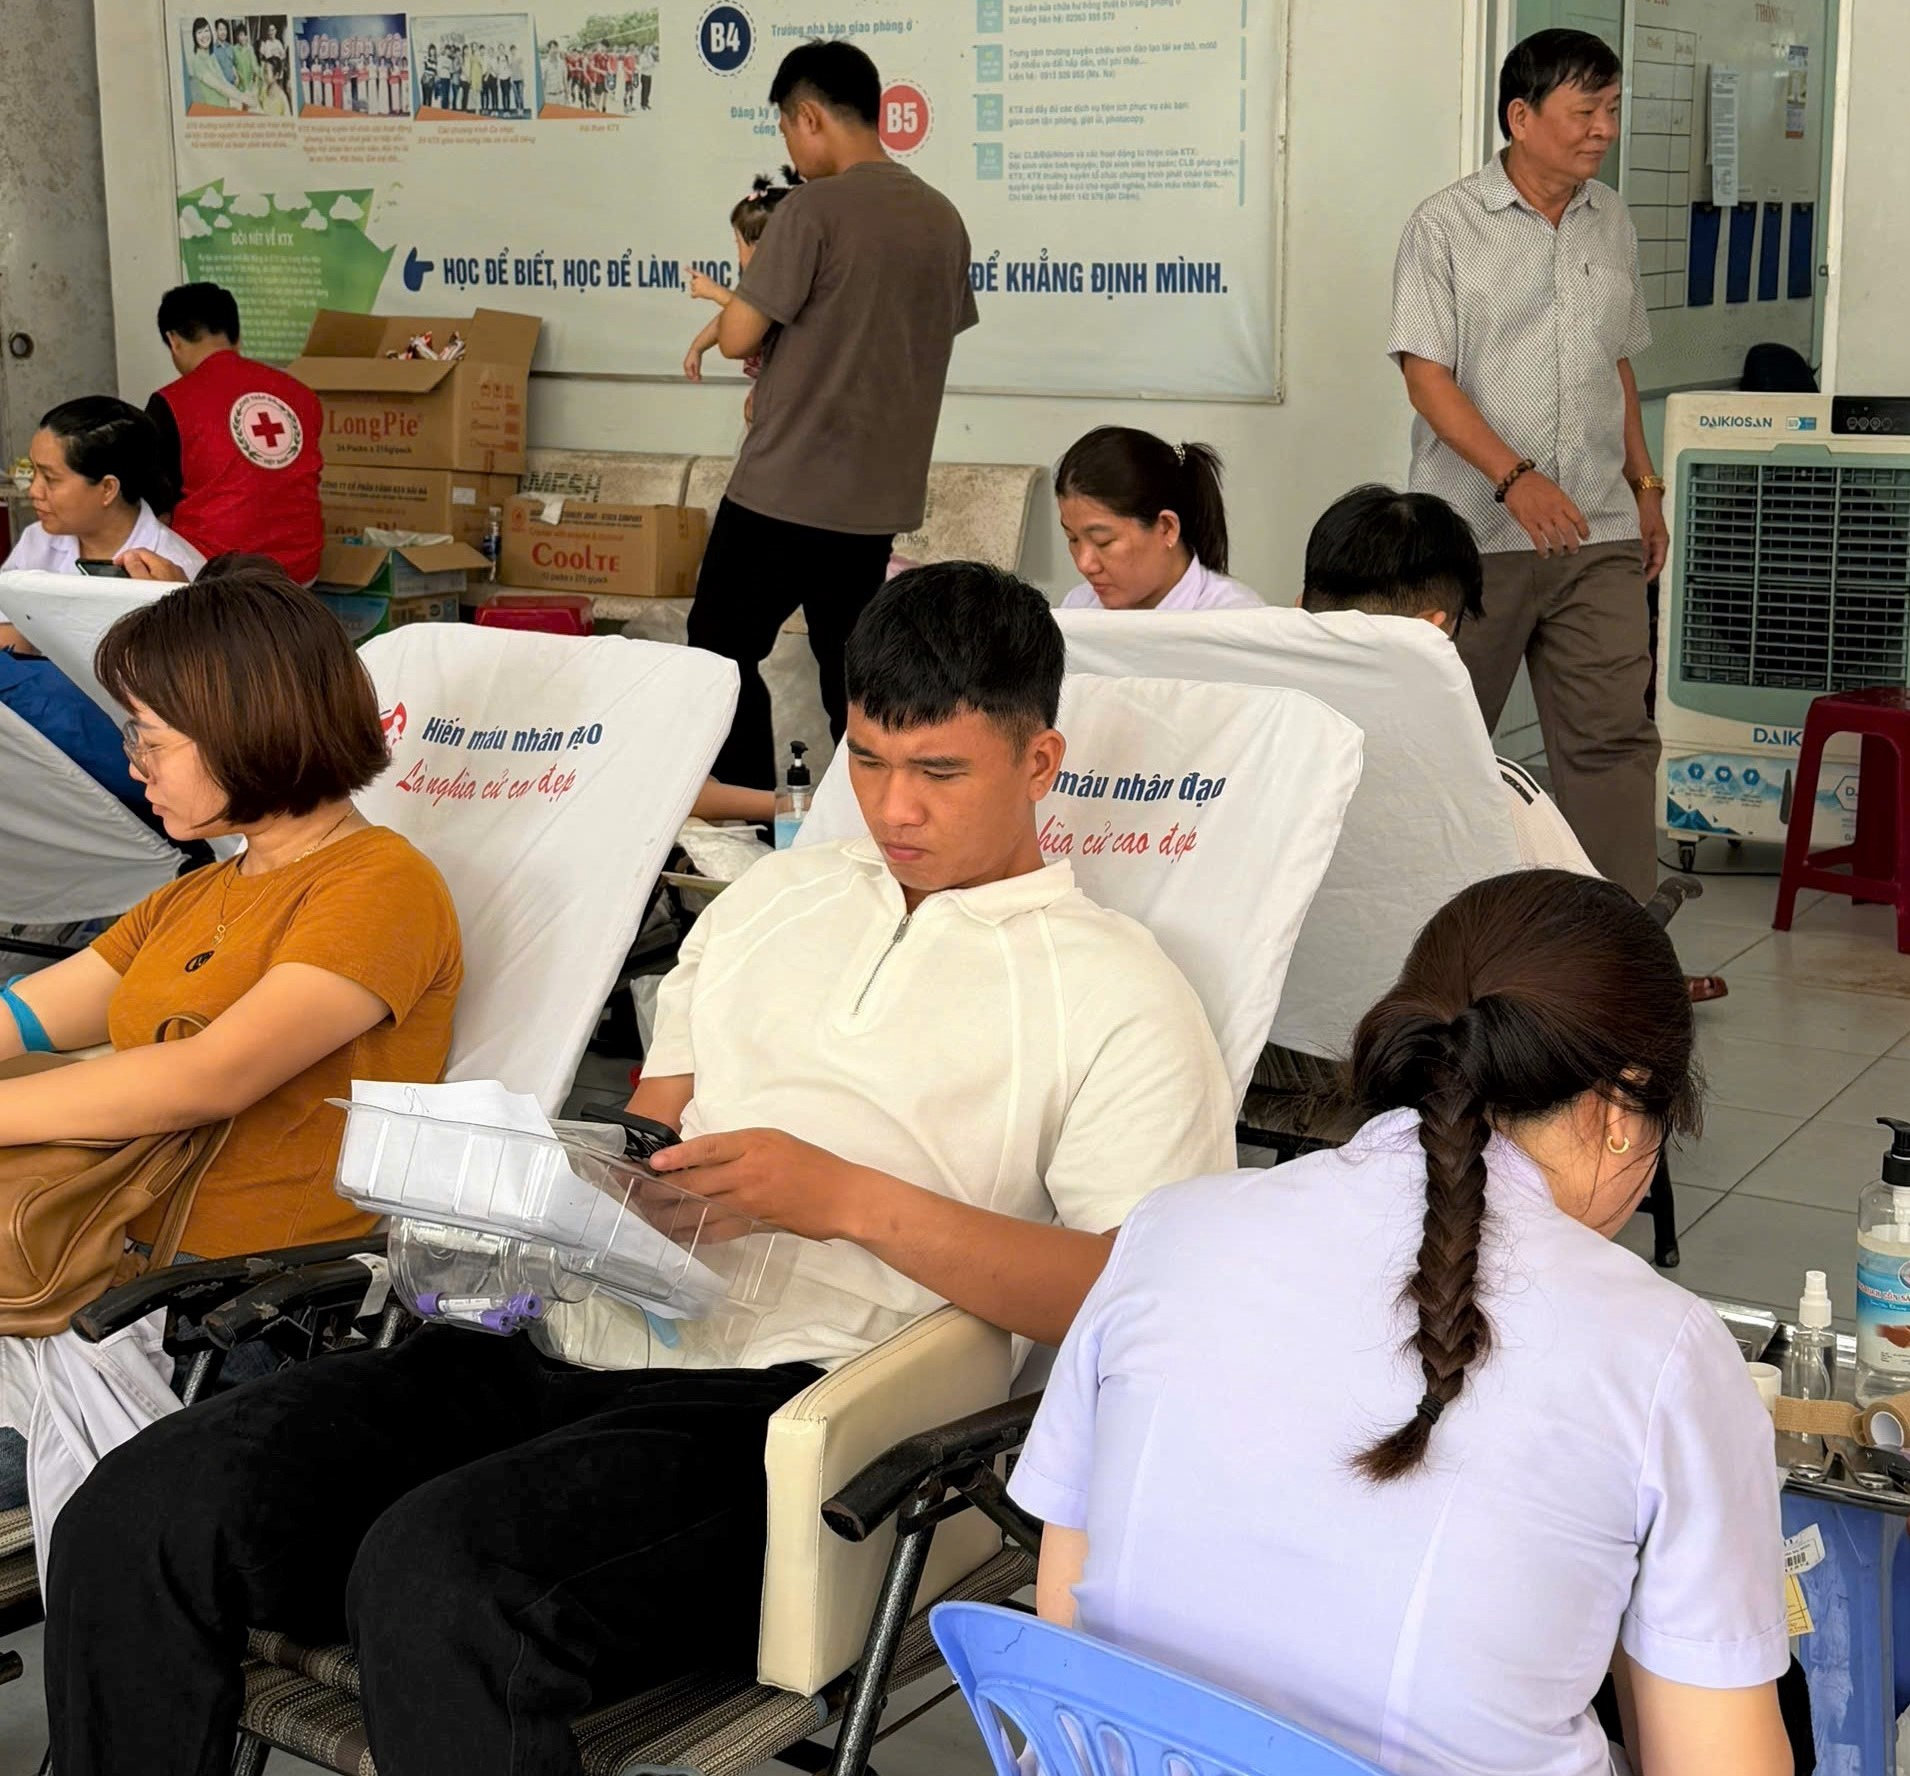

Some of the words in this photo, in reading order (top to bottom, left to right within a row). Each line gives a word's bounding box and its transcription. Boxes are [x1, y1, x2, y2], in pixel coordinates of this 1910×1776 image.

[709, 22, 741, 53] B4
[886, 102, 918, 134] B5
[443, 257, 480, 291] HỌC
[485, 247, 510, 286] ĐỂ
[514, 249, 557, 290] BIẾT,
[563, 258, 601, 294] HỌC
[607, 248, 633, 289] ĐỂ
[638, 254, 686, 292] LÀM,
[968, 250, 1001, 293] ĐỂ
[1006, 247, 1084, 293] KHẲNG
[1090, 261, 1148, 300] ĐỊNH
[1155, 256, 1228, 294] MÌNH.
[328, 409, 419, 443] LongPie
[1699, 415, 1773, 429] DAIKIOSAN
[422, 716, 466, 747] Hiến
[467, 724, 508, 751] máu
[511, 727, 564, 753] nhân
[538, 763, 577, 803] đẹp
[1051, 769, 1110, 799] máu
[1112, 773, 1175, 802] nhân
[1178, 770, 1227, 808] đạo
[1037, 814, 1074, 856] hĩa
[1082, 820, 1113, 857] cử
[1111, 831, 1150, 855] cao
[1159, 821, 1198, 864] đẹp
